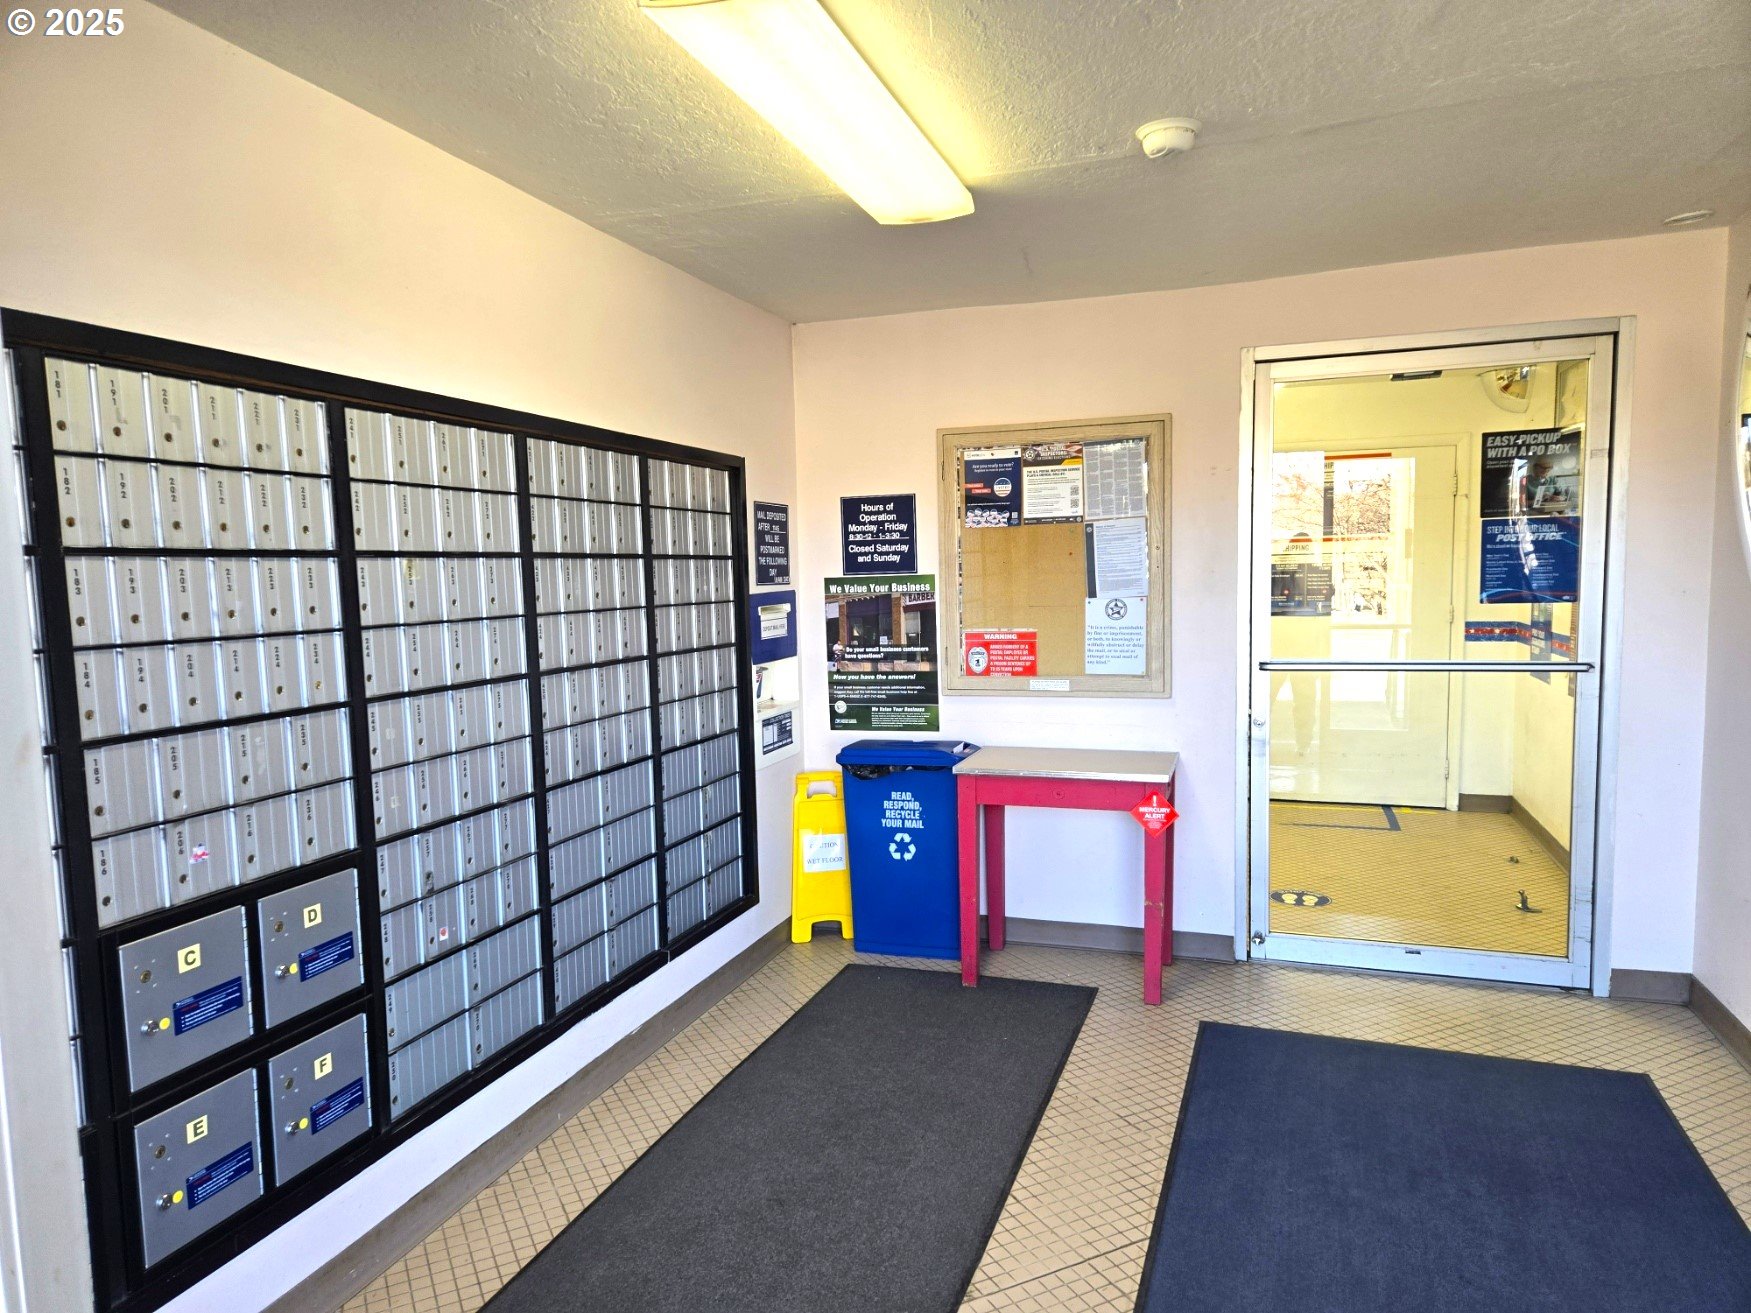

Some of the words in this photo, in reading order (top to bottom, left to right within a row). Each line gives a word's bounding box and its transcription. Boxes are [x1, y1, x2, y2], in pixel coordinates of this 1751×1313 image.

[1486, 435, 1518, 447] EASY
[1519, 432, 1562, 444] PICKUP
[1487, 447, 1518, 459] WITH
[1518, 446, 1527, 457] A
[1528, 444, 1546, 456] PO
[1547, 443, 1572, 455] BOX
[860, 503, 884, 512] Hours
[885, 502, 894, 511] of
[859, 512, 897, 524] Operation
[758, 522, 770, 531] AFTER
[848, 524, 878, 533] Monday
[884, 522, 908, 532] Friday
[1487, 525, 1504, 534] STEP
[1539, 523, 1559, 533] LOCAL
[1495, 533, 1524, 542] POST
[760, 545, 785, 554] POSTMARKED
[848, 544, 875, 553] Closed
[875, 543, 909, 553] Saturday
[766, 556, 787, 566] FOLLOWING
[857, 554, 872, 563] and
[873, 553, 901, 563] Sunday
[768, 568, 777, 577] DAY
[829, 585, 842, 594] We
[844, 584, 867, 593] Value
[869, 583, 889, 593] Your
[891, 583, 930, 592] Business
[186, 654, 194, 678] 204
[83, 662, 91, 688] 184
[170, 746, 178, 771] 205
[93, 758, 101, 785] 185
[891, 791, 915, 801] READ,
[883, 800, 923, 811] RESPOND,
[885, 810, 920, 819] RECYCLE
[881, 818, 903, 828] YOUR
[904, 819, 925, 829] MAIL
[807, 857, 821, 865] WET
[821, 856, 844, 864] FLOOR
[307, 909, 318, 922] D
[184, 950, 197, 966] C
[319, 1058, 328, 1074] F
[192, 1120, 204, 1139] E
